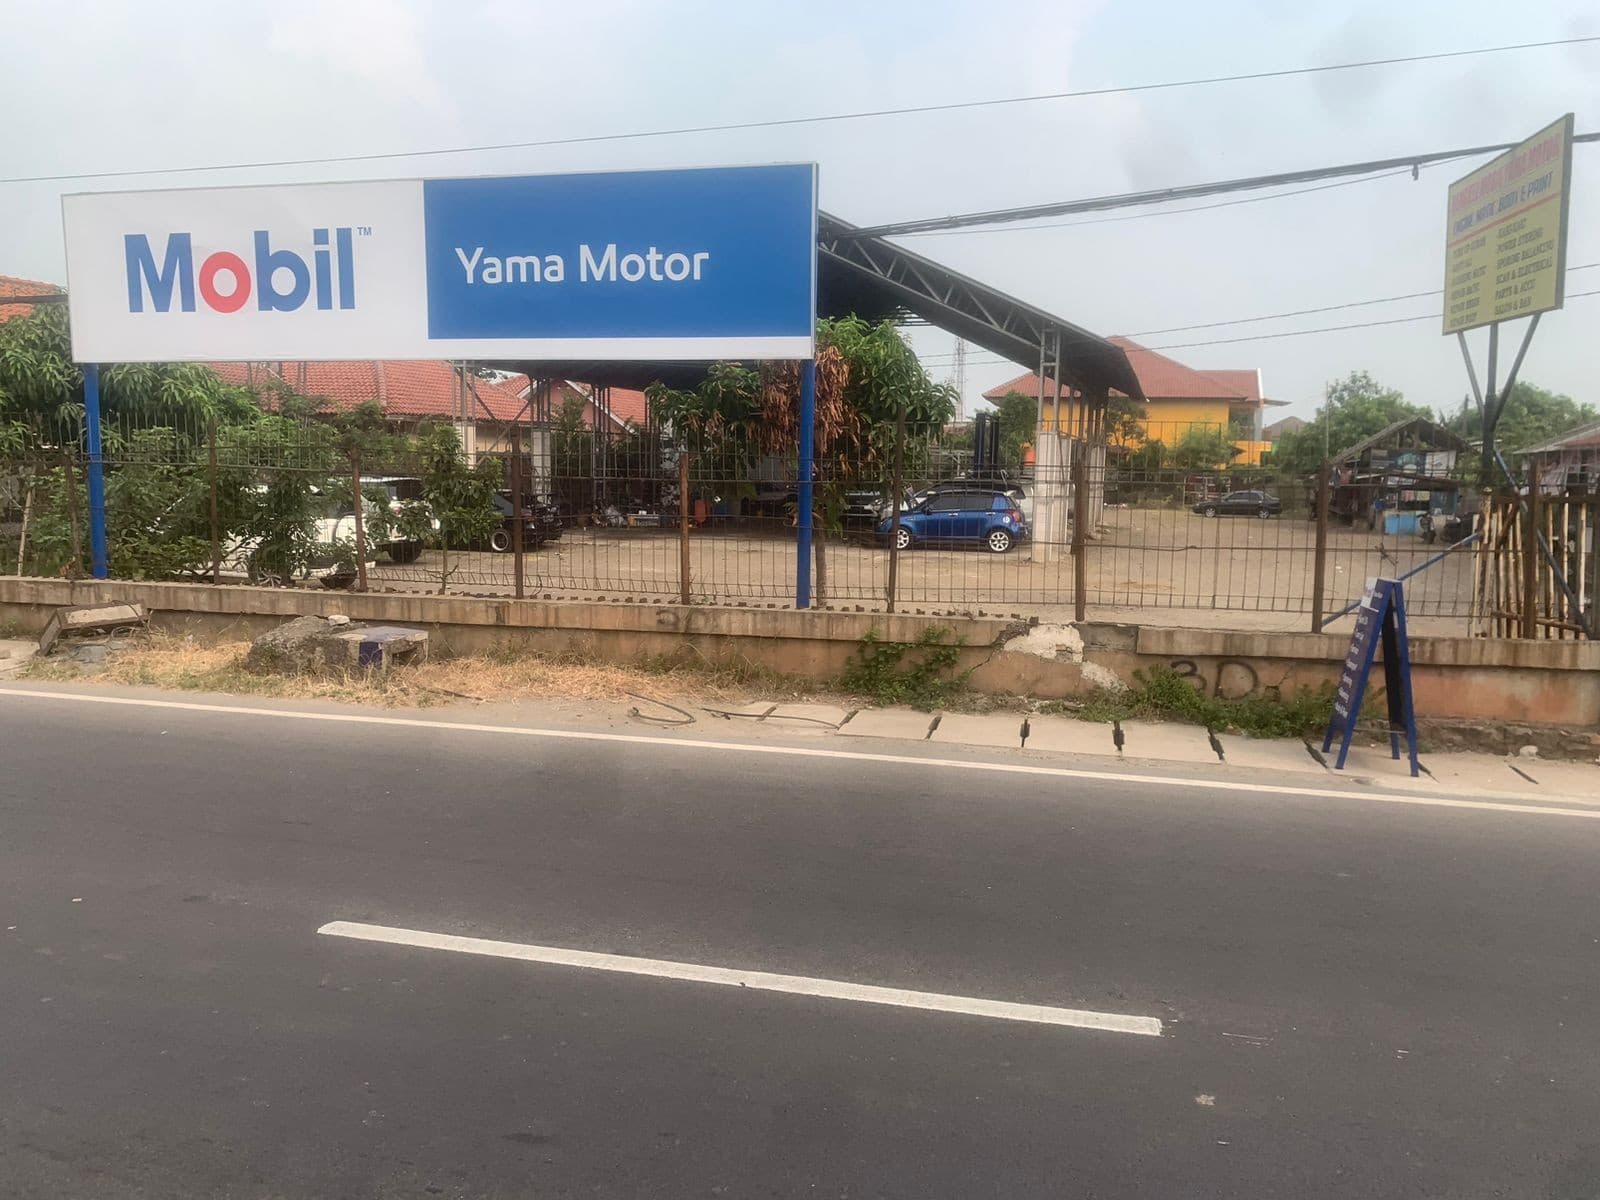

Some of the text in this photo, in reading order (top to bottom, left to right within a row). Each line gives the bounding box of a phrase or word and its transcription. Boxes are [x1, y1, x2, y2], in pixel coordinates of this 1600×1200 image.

[124, 228, 355, 313] Mobil
[455, 244, 710, 285] Yama Motor
